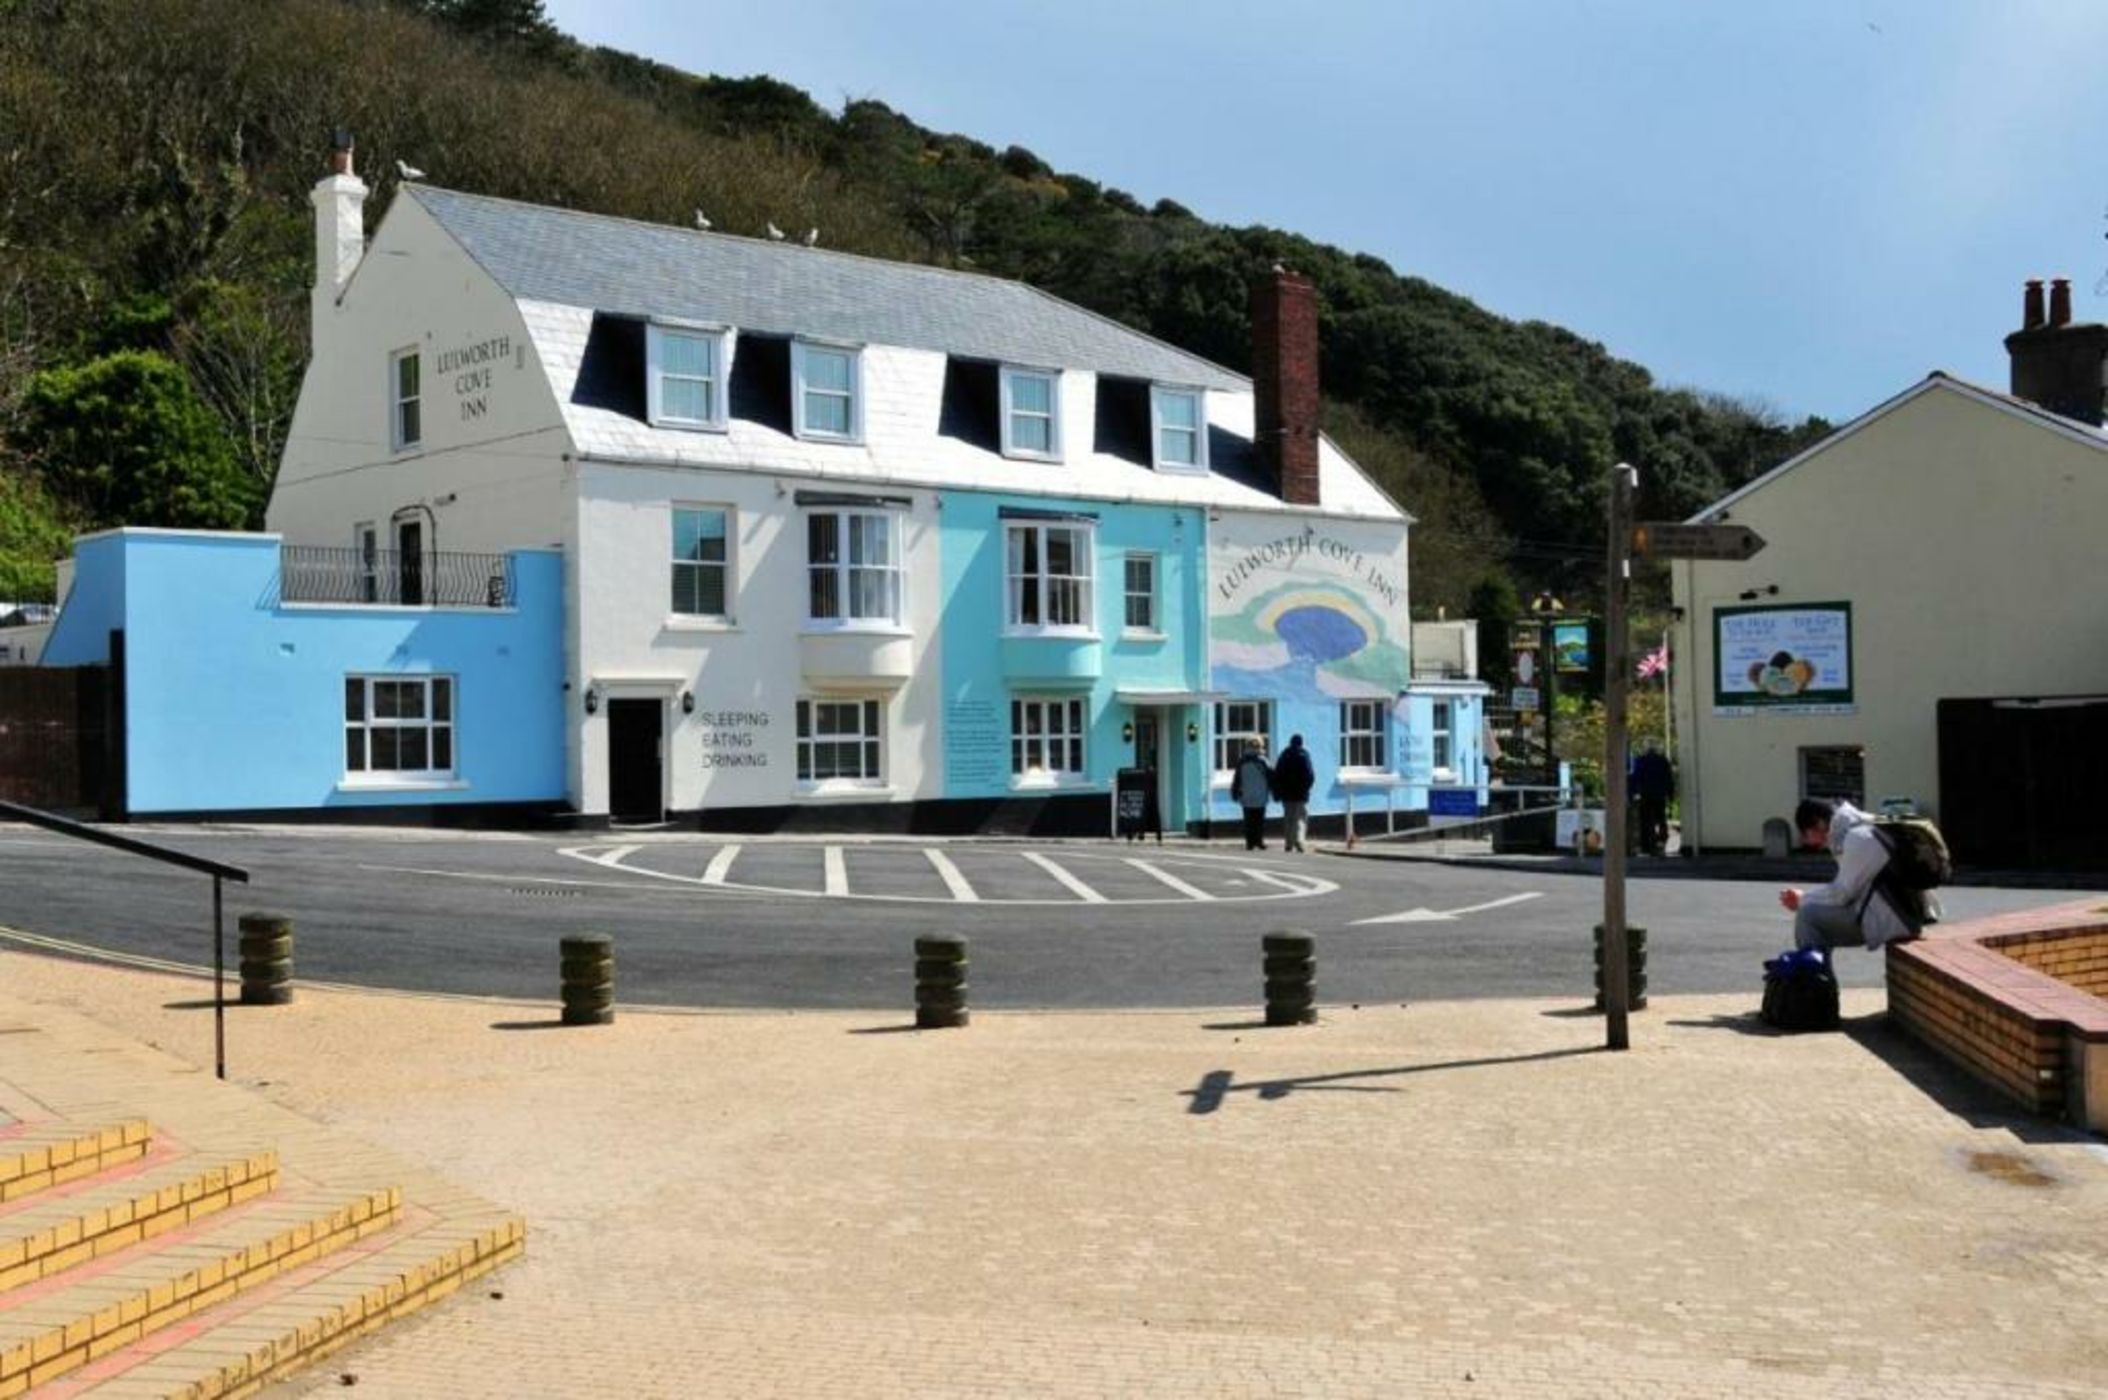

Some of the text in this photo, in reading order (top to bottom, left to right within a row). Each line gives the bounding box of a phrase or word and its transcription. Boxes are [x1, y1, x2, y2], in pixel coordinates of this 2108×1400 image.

[437, 336, 510, 374] LULWORTH
[456, 368, 491, 394] COVE
[461, 398, 487, 421] INN
[1218, 534, 1398, 607] LULWORTH COVE INN
[702, 712, 769, 727] SLEEPING
[702, 732, 752, 747] EATING
[701, 754, 768, 768] DRINKING
